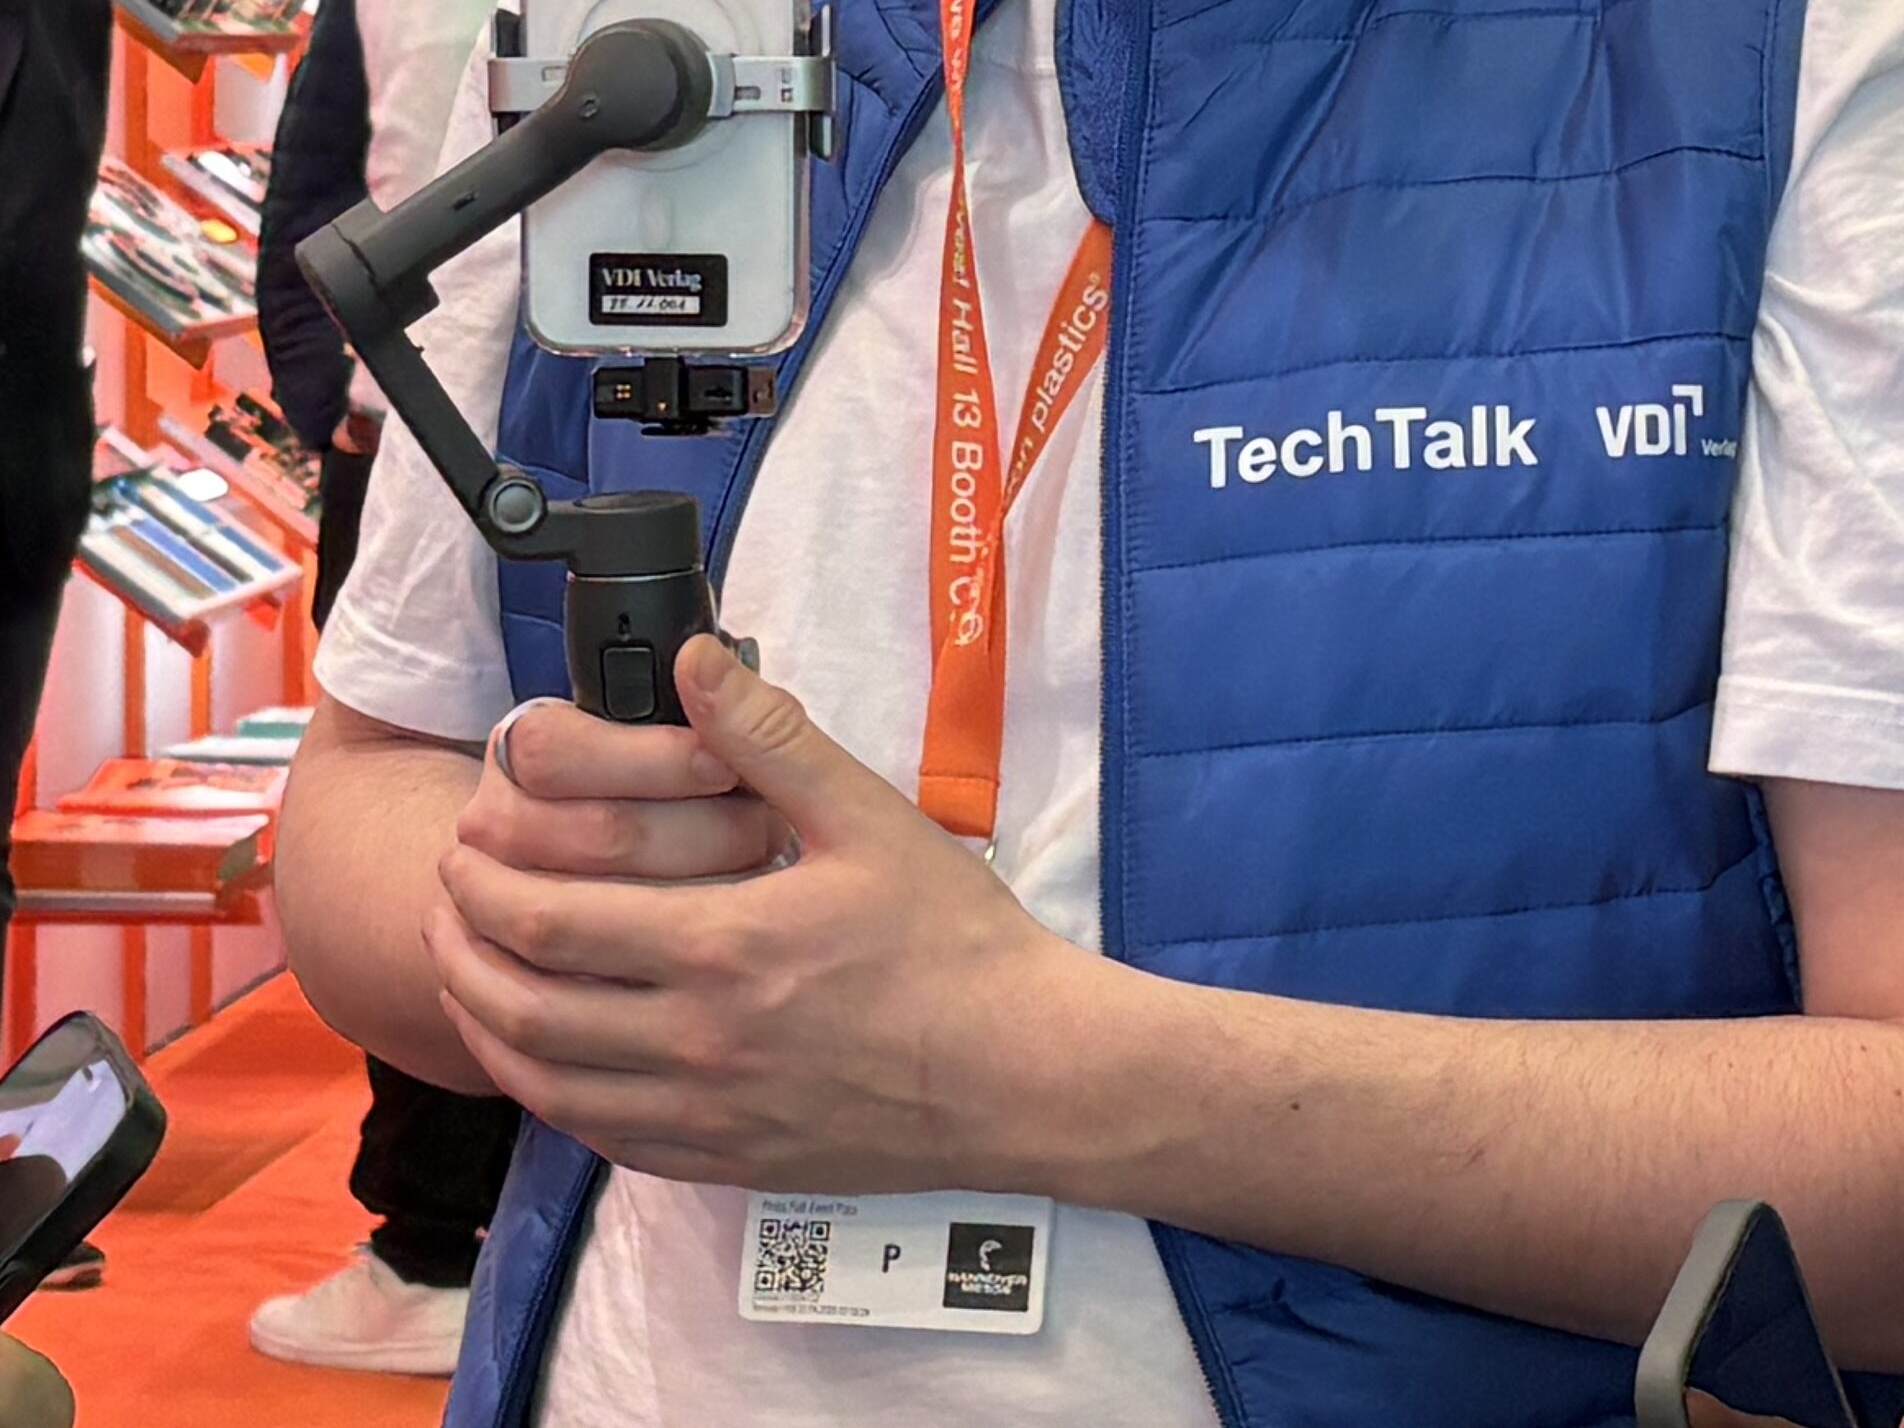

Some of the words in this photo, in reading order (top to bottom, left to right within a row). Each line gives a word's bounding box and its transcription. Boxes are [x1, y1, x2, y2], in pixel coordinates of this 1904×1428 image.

[602, 268, 642, 287] VDI
[647, 269, 702, 292] Verlag
[952, 298, 979, 374] Hall
[952, 389, 983, 429] 13
[1194, 403, 1537, 488] TechTalk
[1595, 394, 1694, 457] VDI
[949, 441, 983, 564] Booth
[882, 1244, 901, 1273] P
